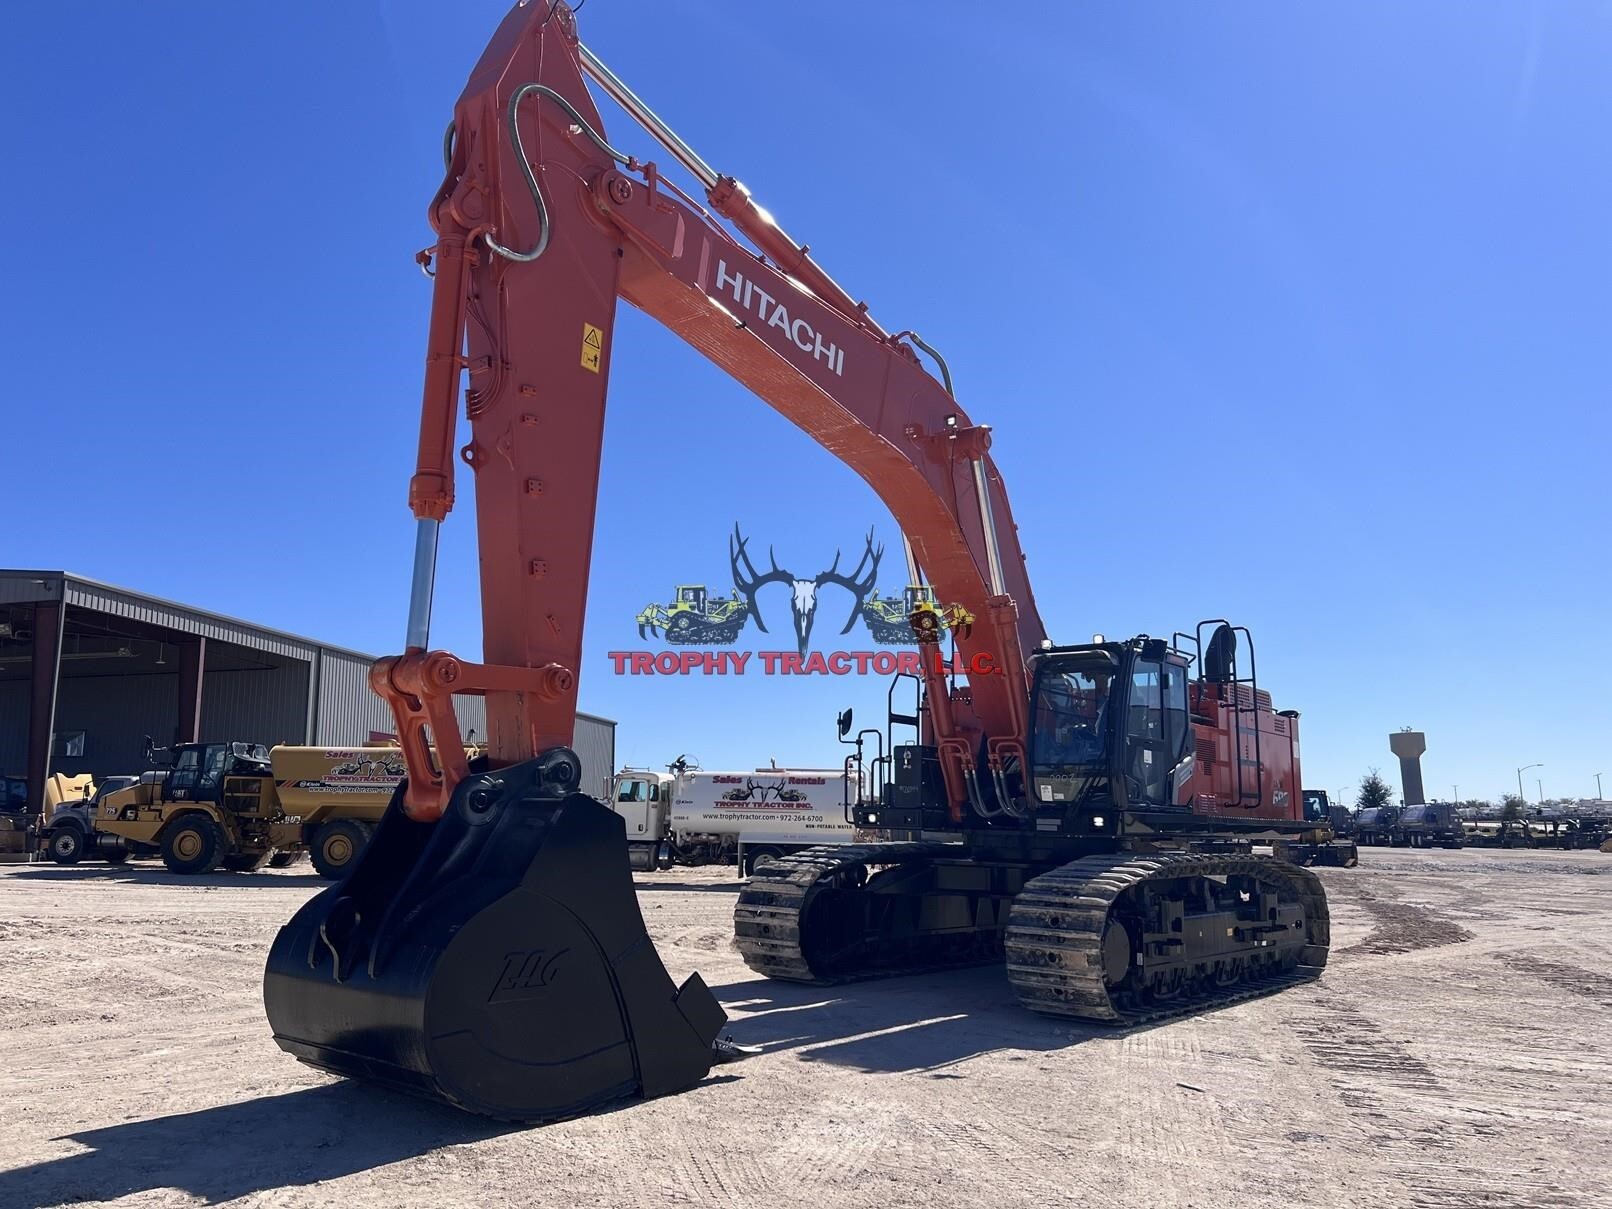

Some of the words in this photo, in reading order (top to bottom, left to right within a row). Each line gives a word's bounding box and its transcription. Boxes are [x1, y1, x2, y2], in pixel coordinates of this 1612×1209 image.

[716, 259, 844, 377] HITACHI
[713, 776, 742, 784] Sales
[788, 777, 826, 785] Rentals
[702, 813, 776, 821] www.trophytractor.com
